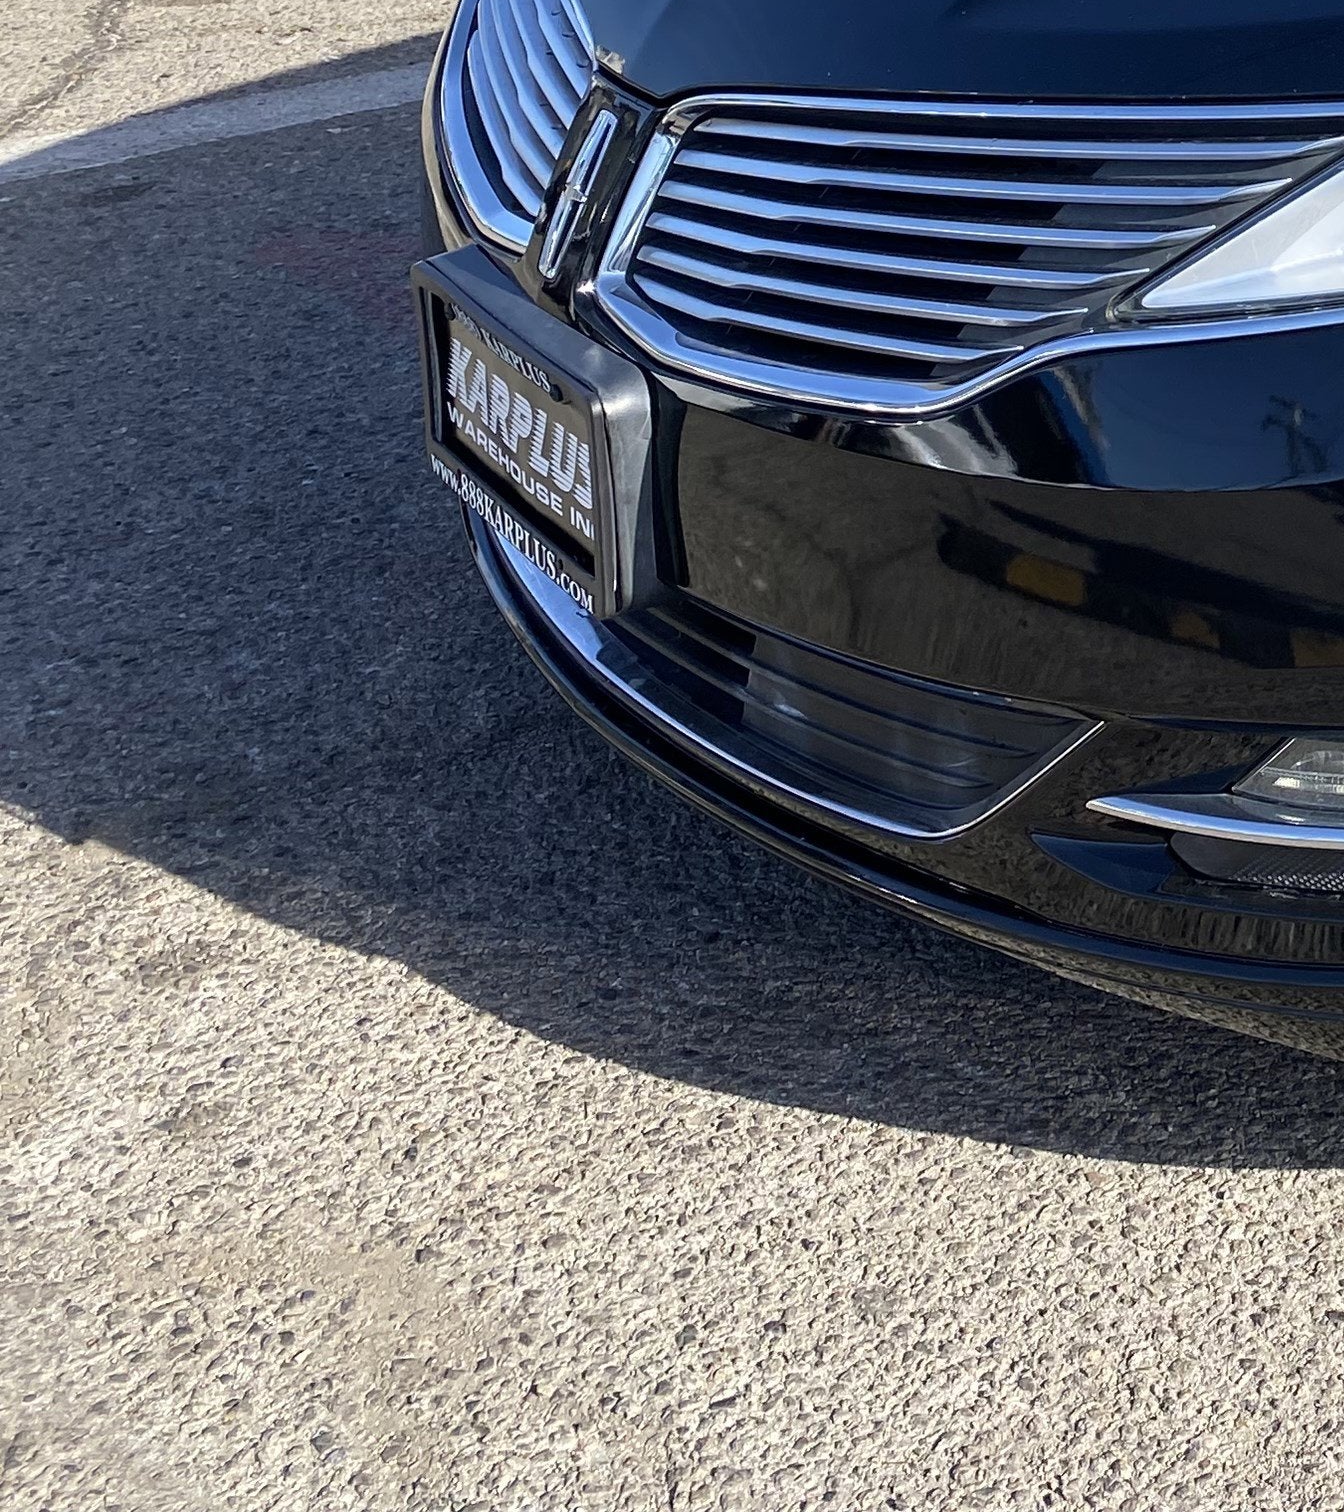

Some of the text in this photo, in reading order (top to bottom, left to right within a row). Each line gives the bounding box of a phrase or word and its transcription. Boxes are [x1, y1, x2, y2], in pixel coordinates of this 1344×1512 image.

[480, 327, 551, 393] KARPLUS
[446, 337, 593, 510] KARPLUS
[447, 401, 563, 516] WAREHOUSE
